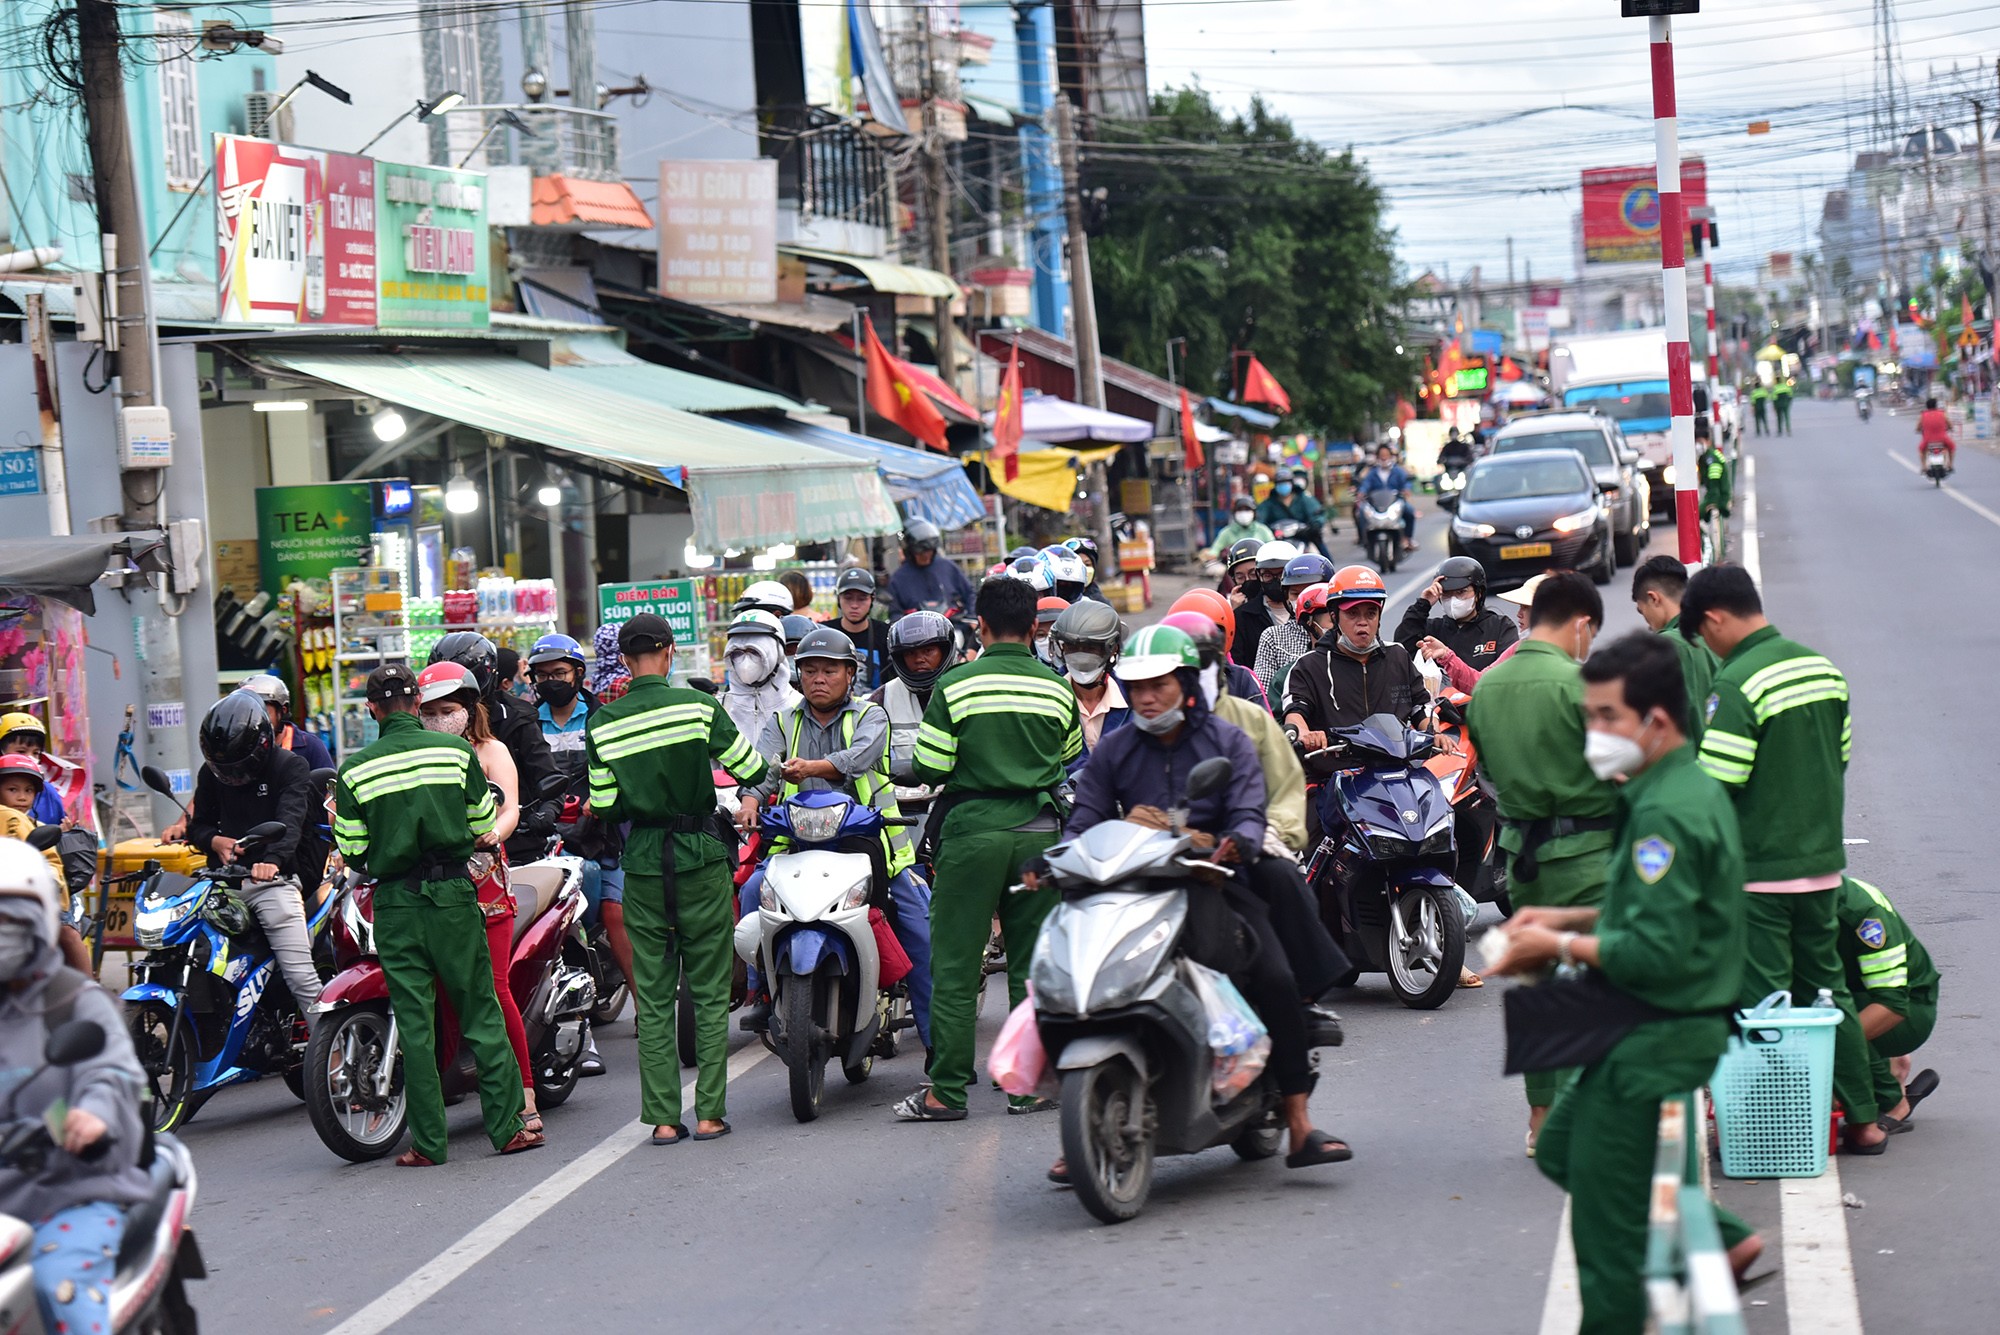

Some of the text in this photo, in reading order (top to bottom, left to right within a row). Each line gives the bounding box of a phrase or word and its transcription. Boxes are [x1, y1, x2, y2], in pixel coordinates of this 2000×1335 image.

[27, 457, 34, 473] 3
[615, 586, 678, 602] ĐIỂM BÁN
